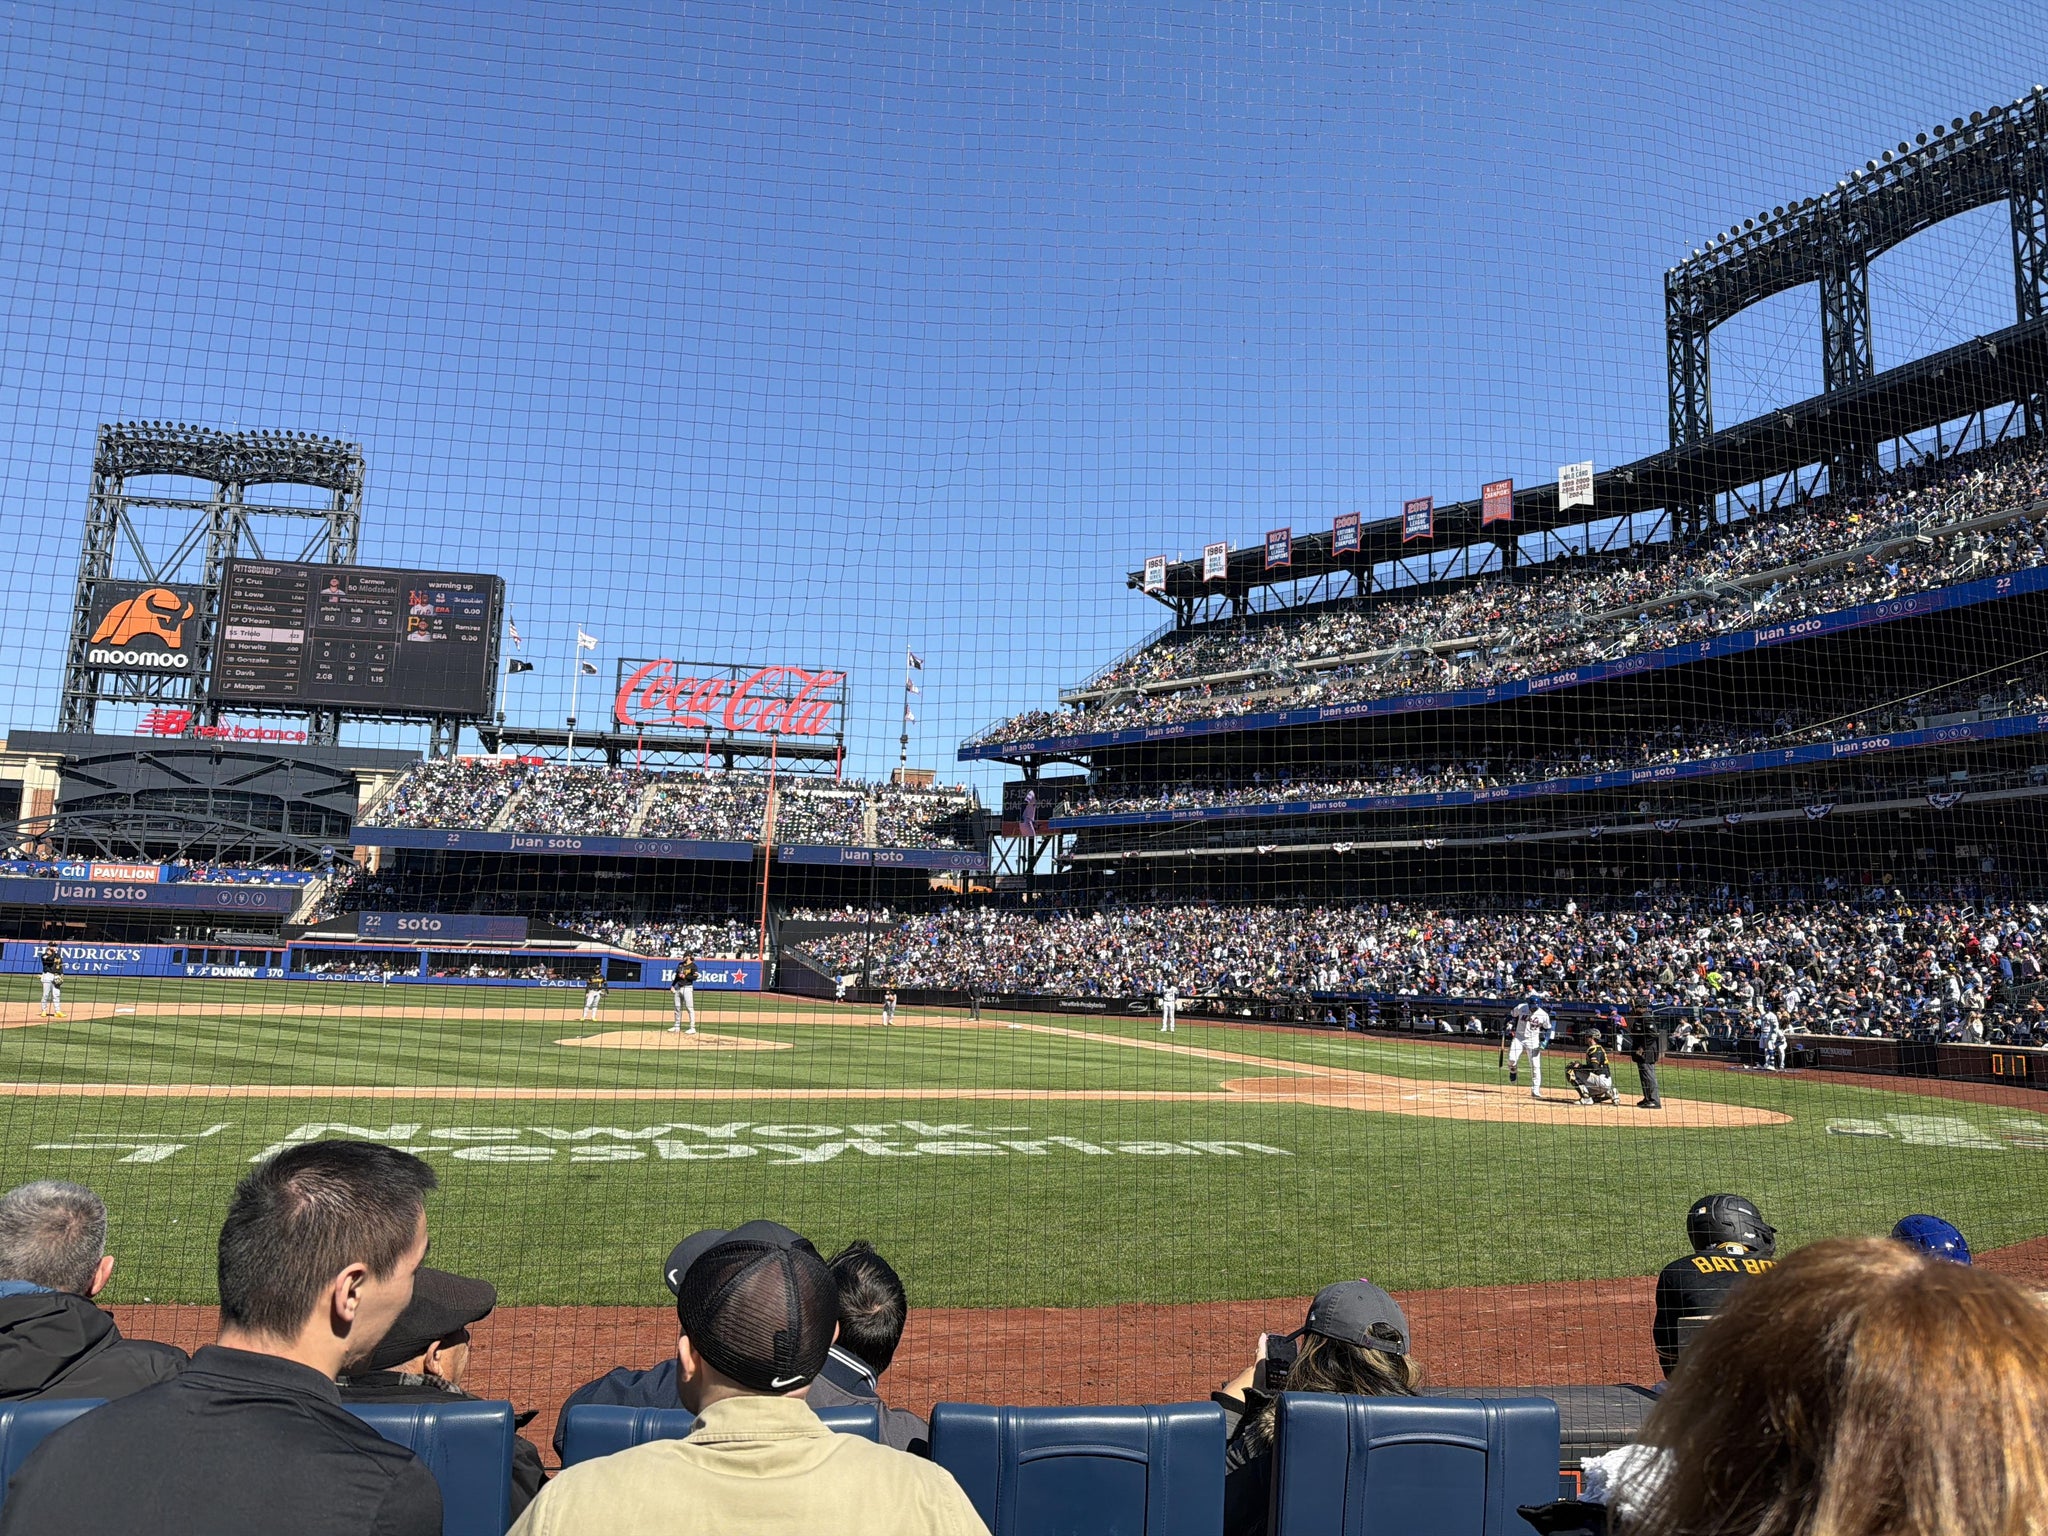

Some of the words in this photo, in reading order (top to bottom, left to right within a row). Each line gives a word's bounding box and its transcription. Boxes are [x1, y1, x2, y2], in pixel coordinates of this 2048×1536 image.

[1484, 489, 1511, 499] CHAMPIONS
[1335, 515, 1358, 529] 2000
[1405, 524, 1430, 534] CHAMPIONS
[1334, 538, 1358, 548] CHAMPIONS
[1207, 545, 1224, 556] 1986
[233, 564, 274, 575] PITTSBURGH
[359, 578, 386, 586] Carmen
[428, 581, 462, 591] warming
[1996, 577, 2011, 589] 22
[358, 586, 398, 595] Mlodzinski
[242, 605, 276, 613] Reynolds
[463, 607, 481, 615] 0.00
[351, 616, 362, 624] 28
[407, 616, 420, 632] P
[1699, 642, 1710, 651] 22
[1755, 627, 1784, 646] juan
[1789, 619, 1822, 635] soto
[238, 643, 267, 651] Horwitz
[88, 649, 189, 668] moomoo
[236, 656, 270, 664] Gonzales
[349, 651, 356, 659] 0
[374, 653, 385, 661] 4.1
[235, 669, 256, 677] Davis
[315, 672, 333, 680] 2.08
[370, 675, 384, 683] 1.15
[233, 682, 266, 692] Mangum
[1486, 688, 1496, 696] 22
[1528, 679, 1550, 693] juan
[1553, 672, 1578, 684] soto
[1278, 713, 1288, 721] 22
[1319, 706, 1341, 719] juan
[1344, 704, 1369, 714] soto
[193, 726, 233, 738] new
[234, 725, 306, 742] balance
[1145, 728, 1163, 739] juan
[1166, 725, 1185, 735] soto
[1002, 745, 1017, 754] juan
[1784, 750, 1794, 759] 22
[1832, 743, 1859, 756] juan
[1861, 737, 1891, 749] soto
[1632, 770, 1652, 782] juan
[1654, 767, 1676, 776] soto
[1473, 791, 1490, 802] juan
[1492, 788, 1509, 799] soto
[1309, 803, 1325, 812] juan
[1328, 801, 1347, 809] soto
[446, 834, 460, 842] 22
[510, 835, 544, 849] juan
[548, 839, 582, 849] soto
[782, 847, 795, 856] 22
[839, 848, 869, 863] juan
[874, 852, 904, 862] soto
[62, 865, 85, 877] citi
[94, 866, 155, 879] PAVILION
[52, 882, 96, 901] juan
[103, 886, 147, 900] soto
[365, 916, 381, 926] 22
[397, 916, 442, 931] soto
[33, 946, 141, 961] HNDRICK'S
[211, 967, 258, 977] DUNKIN'
[266, 968, 284, 978] 370
[316, 973, 381, 983] CADILLAC
[539, 979, 587, 987] CADILL
[1691, 1256, 1739, 1274] BAT
